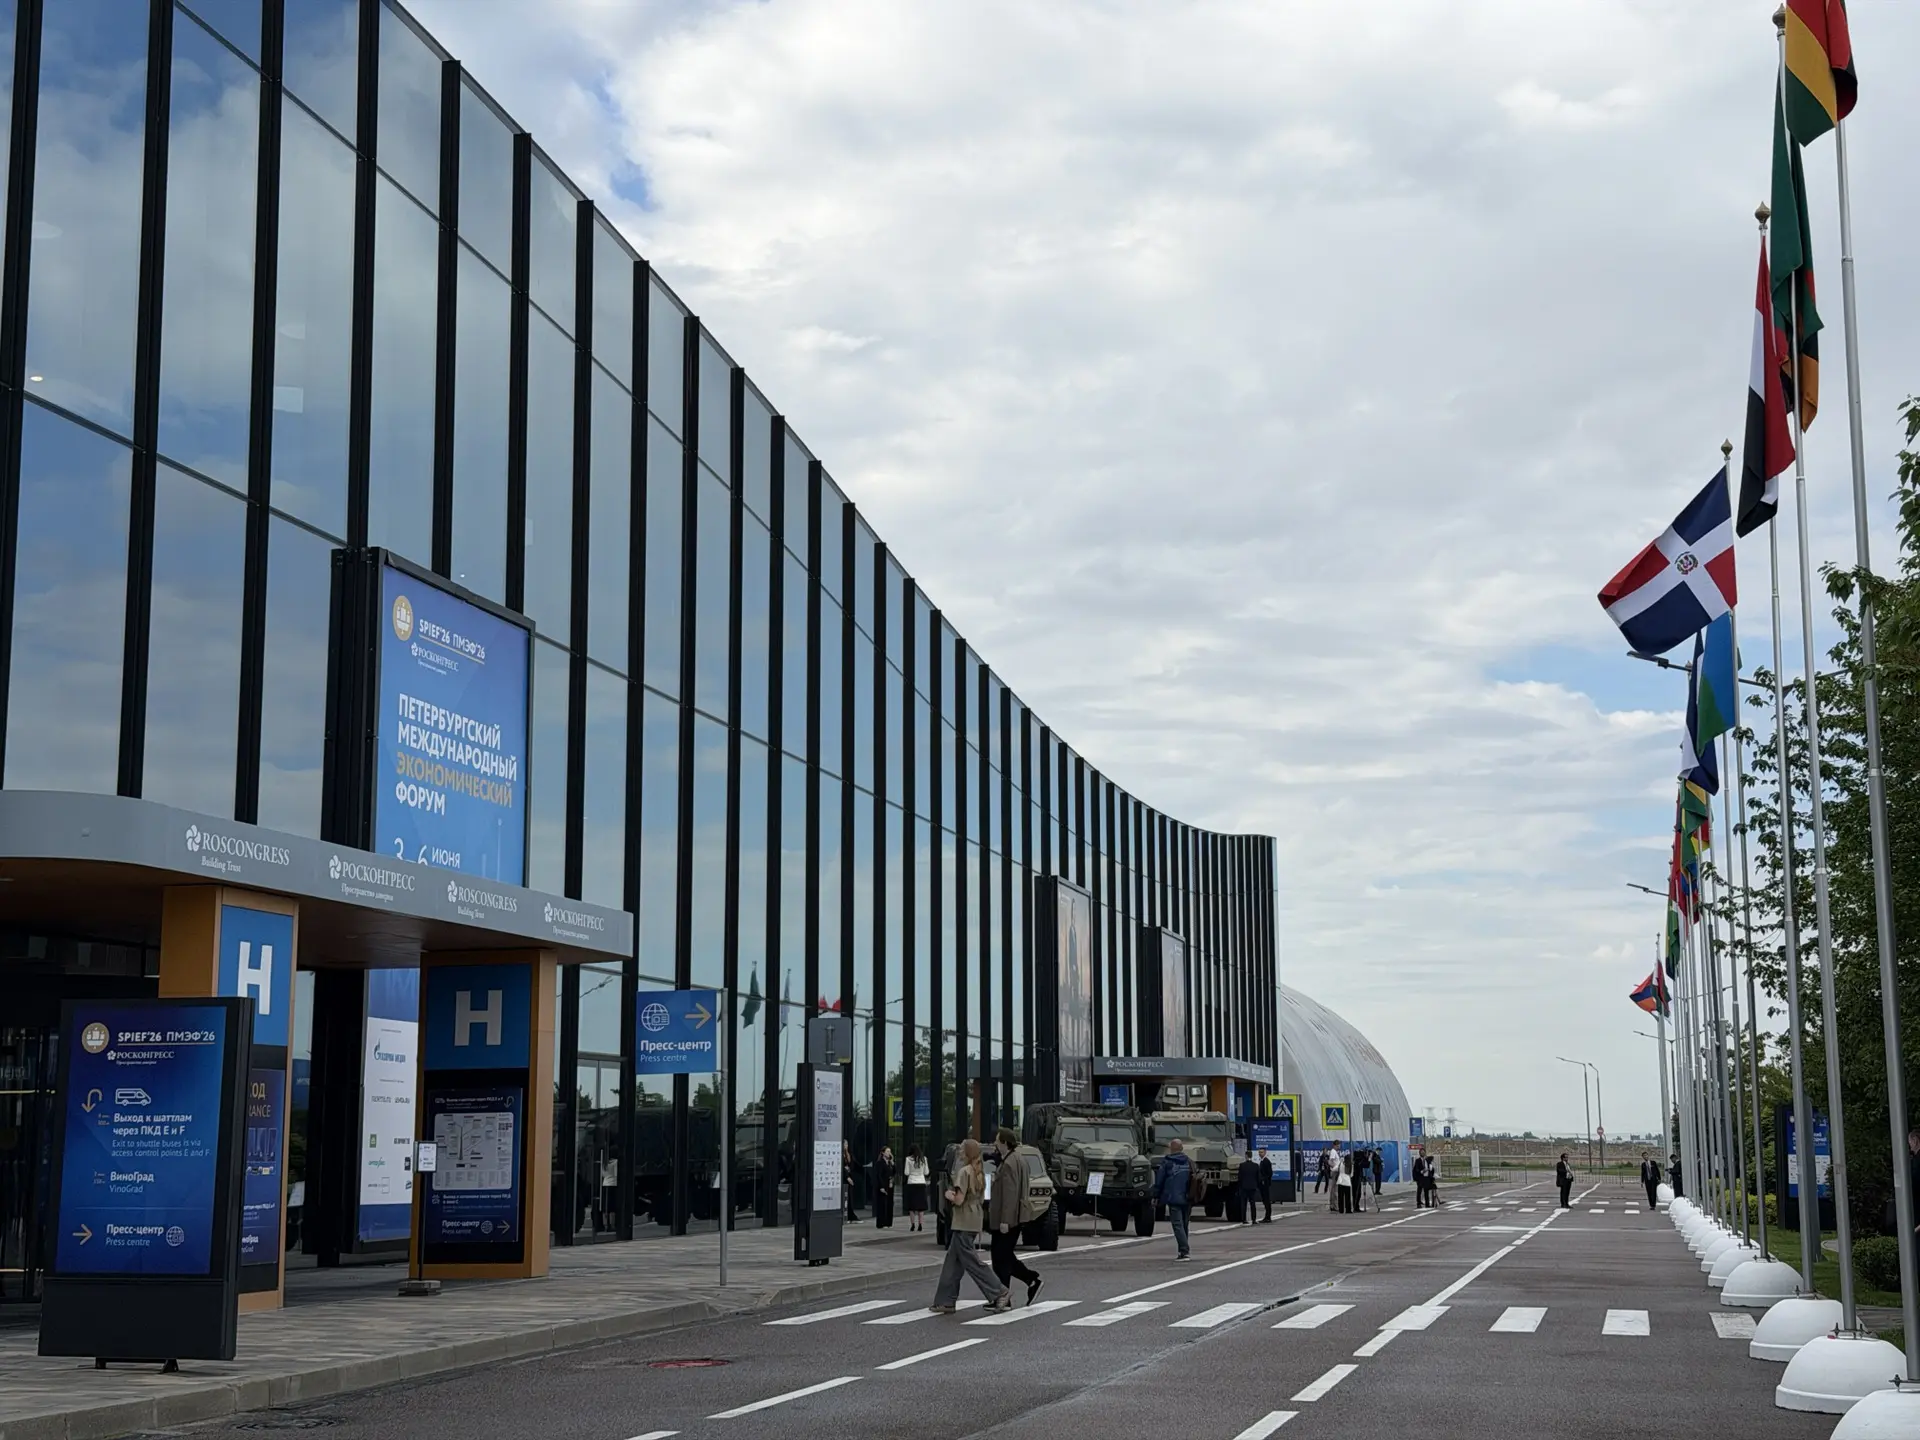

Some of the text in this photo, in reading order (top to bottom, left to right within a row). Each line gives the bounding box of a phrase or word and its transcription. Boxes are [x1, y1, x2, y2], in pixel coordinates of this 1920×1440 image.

[417, 647, 460, 672] РОСКОНГРЕСС
[398, 693, 501, 750] ПЕТЕРБУРГСКИЙ
[398, 721, 517, 782] МЕЖДУНАРОДНЫЙ
[396, 752, 512, 808] ЭКОНОМИЧЕСКИЙ
[395, 781, 446, 815] ФОРУМ
[202, 832, 290, 866] ROSCONGRESS
[201, 855, 241, 873] Building Trust
[342, 861, 415, 891] РОСКОНГРЕСС
[458, 886, 518, 913] ROSCONGRESS
[553, 907, 605, 931] РОСКОНГРЕСС
[117, 1031, 216, 1042] SPIEF'26 ПМЭФ'26
[640, 1039, 712, 1054] Пресс-центр
[116, 1051, 175, 1059] РОСКОНГРЕСС
[640, 1053, 687, 1062] Press centre
[251, 1082, 266, 1100] ОД
[113, 1113, 144, 1123] Выход
[145, 1114, 151, 1122] к
[153, 1114, 192, 1122] шаттлам
[249, 1104, 272, 1118] ANCE
[112, 1127, 139, 1137] через
[140, 1125, 161, 1136] ПКД
[171, 1127, 177, 1135] и
[179, 1126, 186, 1134] F
[136, 1139, 160, 1147] shuttle
[135, 1149, 159, 1157] control
[161, 1149, 182, 1158] points
[110, 1171, 154, 1183] ВиноГрад
[109, 1185, 144, 1193] VinoGrad
[106, 1224, 164, 1236] Пресс-центр
[441, 1219, 480, 1228] Пресс-центр
[105, 1237, 125, 1245] Press
